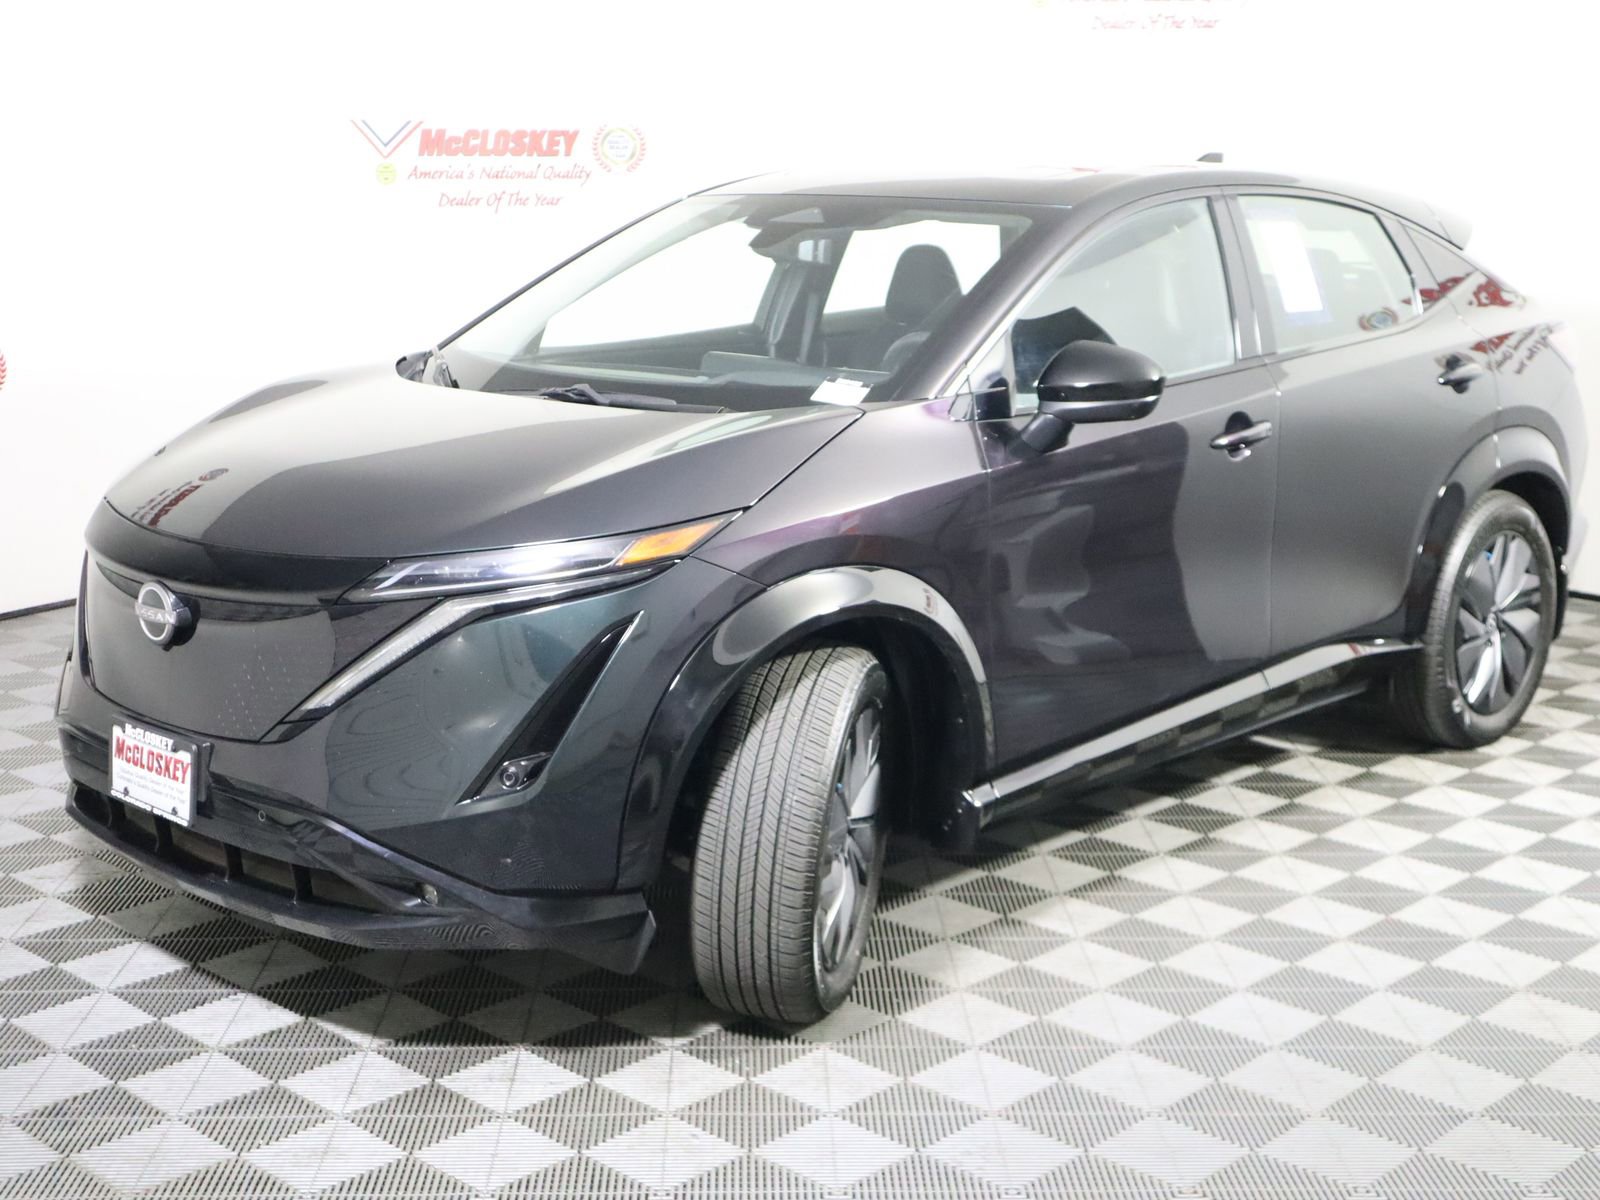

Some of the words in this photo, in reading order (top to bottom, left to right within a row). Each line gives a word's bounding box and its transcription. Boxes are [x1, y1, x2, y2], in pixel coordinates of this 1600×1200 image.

[417, 127, 581, 158] McCLOSKEY
[407, 162, 476, 181] America's
[479, 162, 540, 181] National
[542, 163, 593, 188] Quality
[438, 190, 484, 209] Dealer
[486, 191, 506, 214] Of
[506, 191, 531, 208] The
[534, 191, 564, 208] Year
[125, 723, 174, 752] McCLOSKEY
[114, 735, 191, 785] McCLOSKEY
